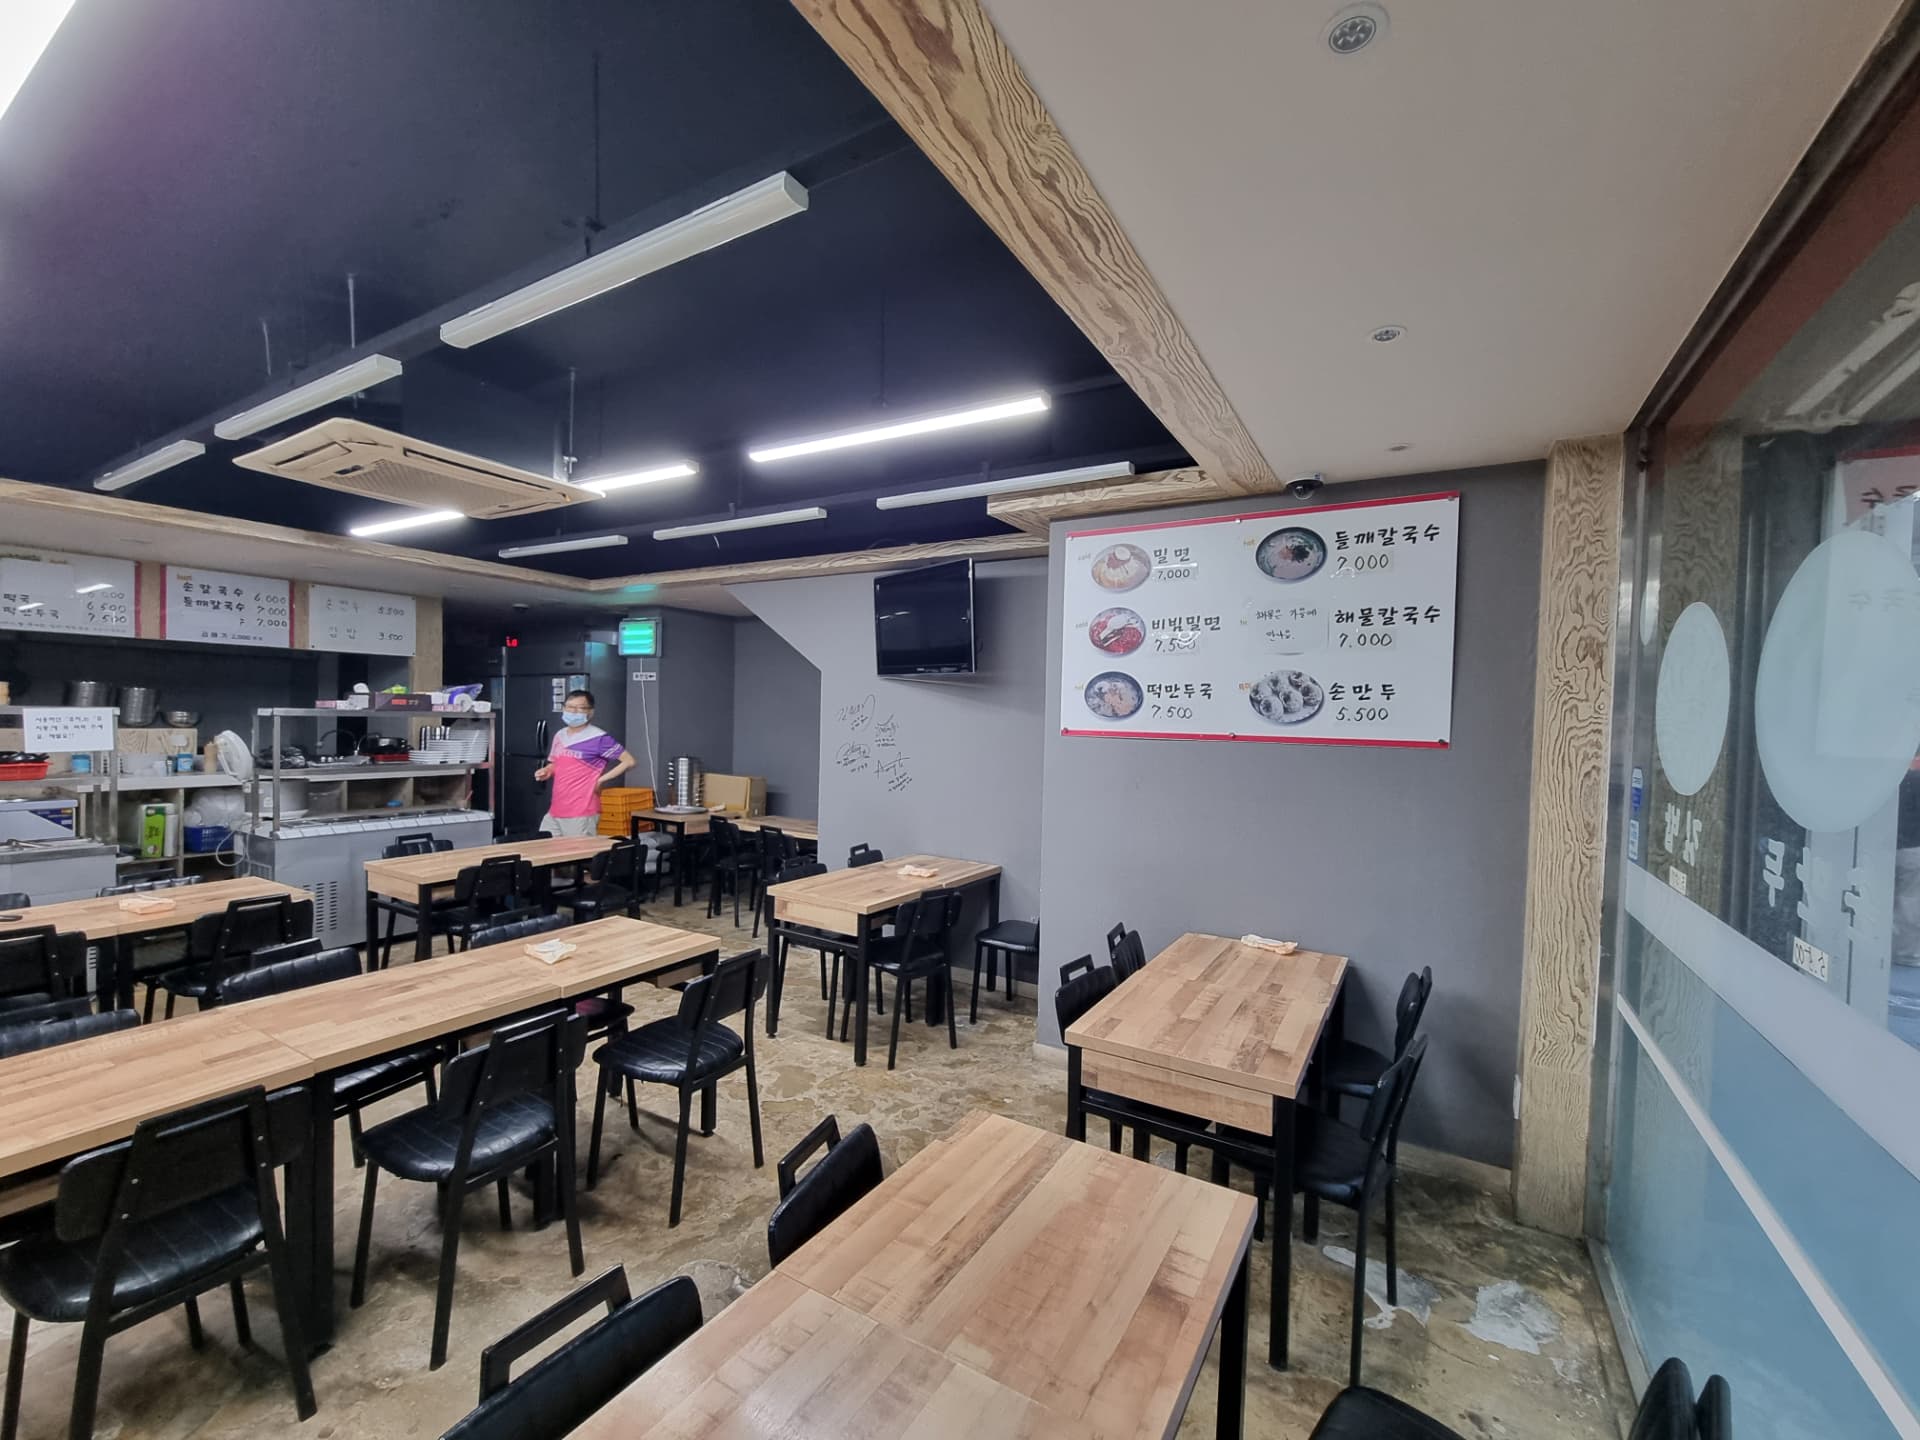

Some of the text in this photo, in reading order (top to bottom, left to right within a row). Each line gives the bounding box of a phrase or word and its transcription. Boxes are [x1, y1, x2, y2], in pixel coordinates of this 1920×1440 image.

[1335, 524, 1440, 550] 들깨칼국수
[1153, 547, 1190, 564] 밀면
[1152, 615, 1221, 632] 비빔밀면
[1334, 605, 1440, 627] 해물칼국수
[1339, 633, 1393, 648] 7.000
[1147, 683, 1213, 699] 떡만두국
[1329, 682, 1396, 701] 손만두
[1152, 705, 1193, 719] 7.500
[1335, 707, 1389, 722] 5.500
